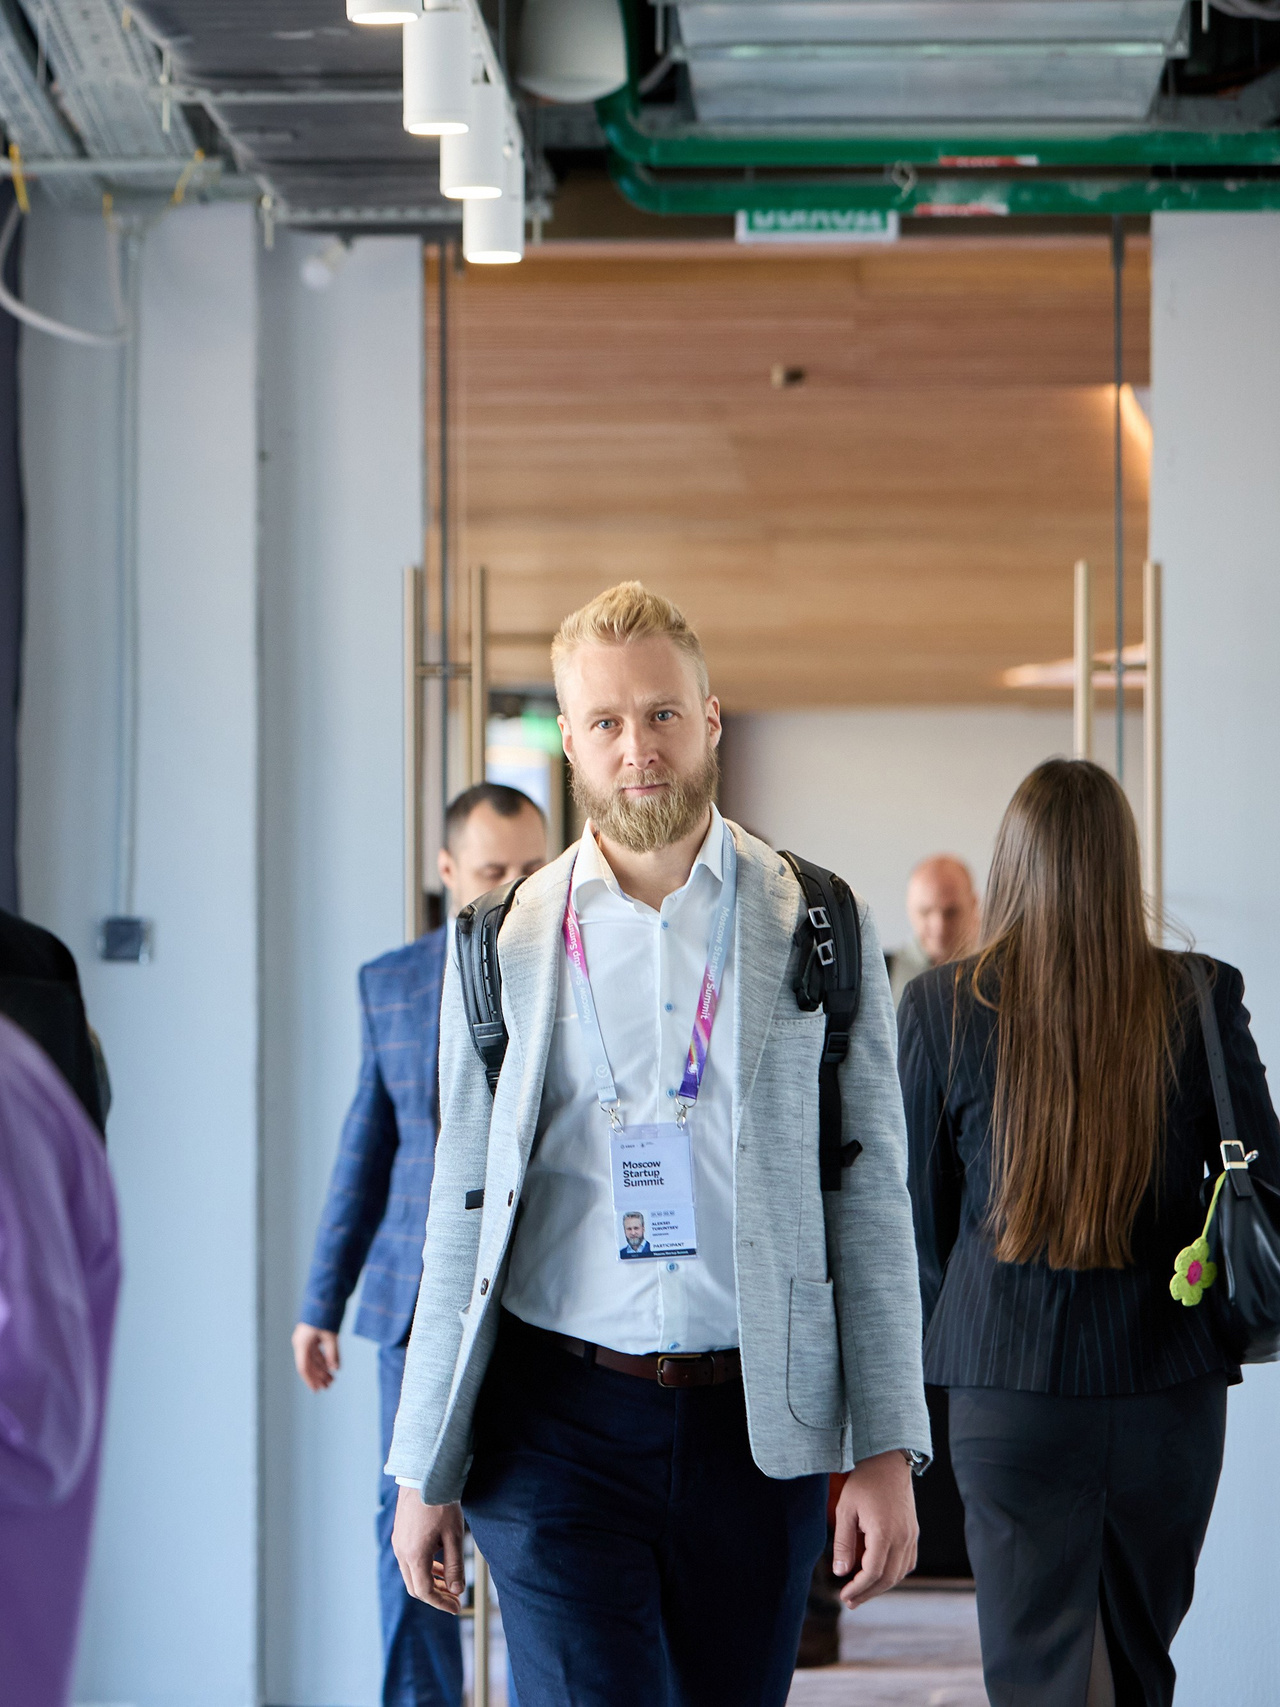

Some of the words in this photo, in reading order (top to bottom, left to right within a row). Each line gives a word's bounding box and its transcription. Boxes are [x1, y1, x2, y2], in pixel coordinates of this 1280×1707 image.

[725, 840, 733, 870] Summit
[716, 906, 730, 944] Moscow
[573, 951, 584, 985] Startup
[706, 946, 722, 982] Startup
[581, 988, 592, 1024] Moscow
[700, 983, 715, 1020] Summit
[622, 1161, 661, 1170] Moscow
[623, 1169, 660, 1179] Startup
[623, 1177, 664, 1188] Summit
